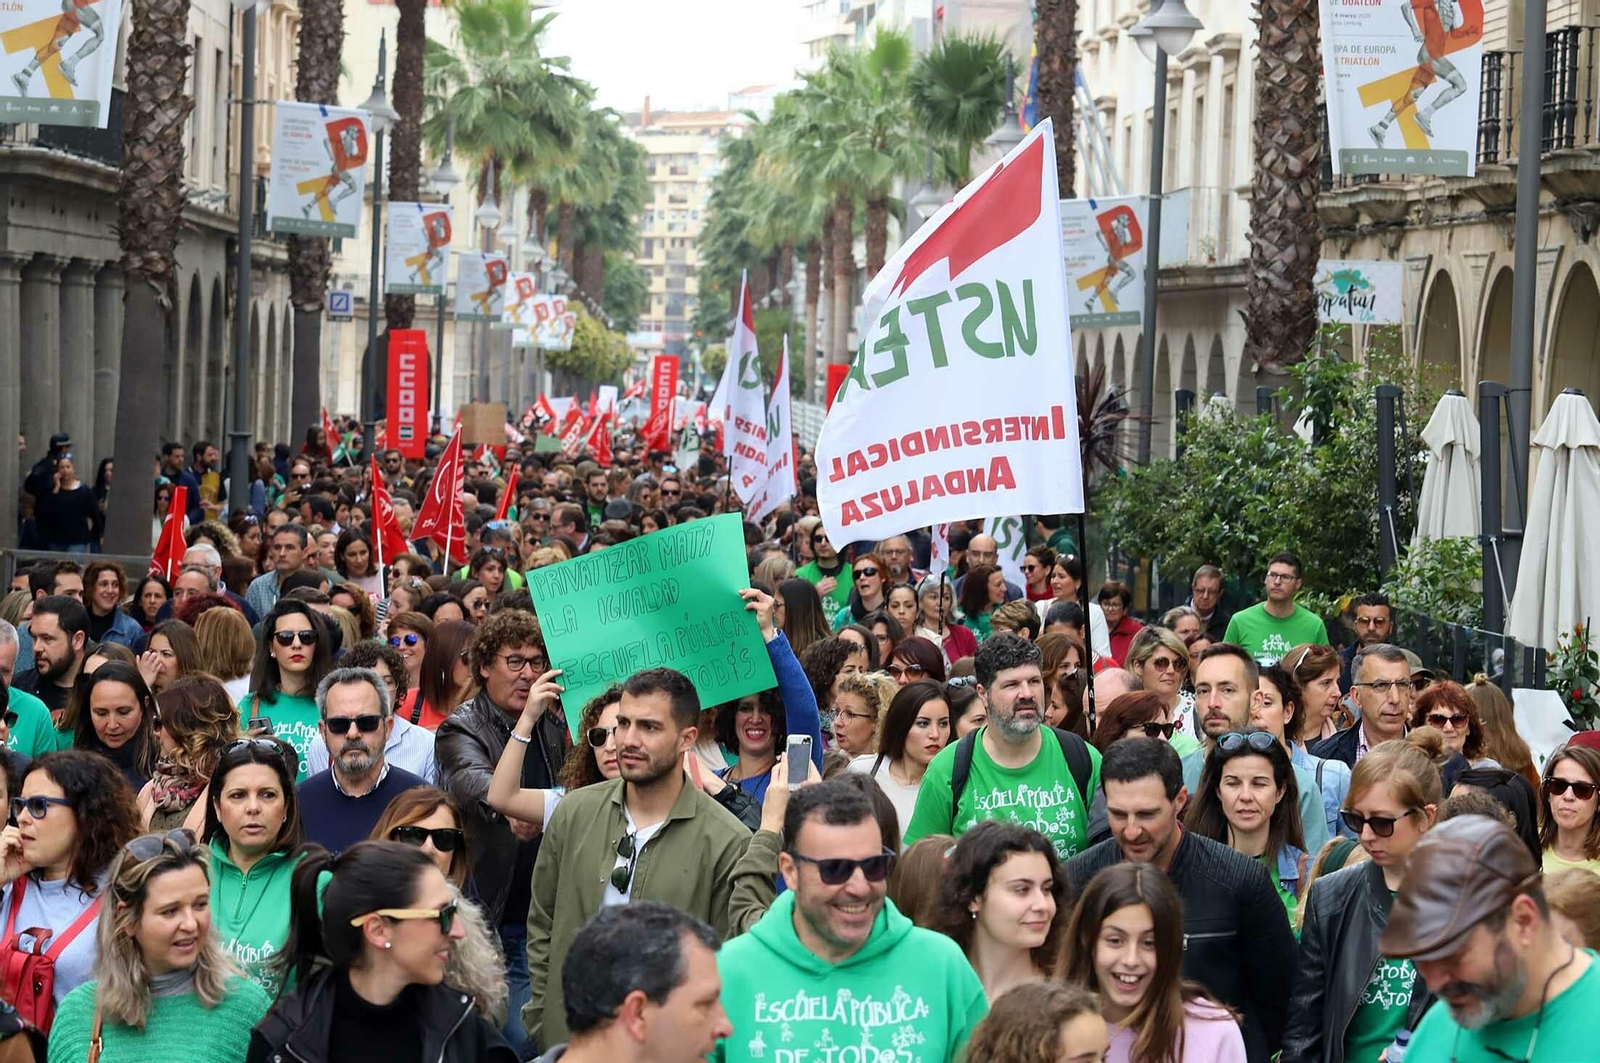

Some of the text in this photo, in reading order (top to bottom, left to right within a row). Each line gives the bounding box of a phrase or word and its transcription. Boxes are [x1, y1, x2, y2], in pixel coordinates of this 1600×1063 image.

[1341, 56, 1380, 66] TRIATLÓN
[1351, 45, 1361, 54] DE
[1363, 45, 1397, 54] EUROPA
[399, 353, 416, 423] CCOO
[533, 522, 716, 602] PRIVATIZAR MATA
[544, 577, 680, 638] LA IGUALDAD
[557, 631, 675, 692] ESCUELA
[1014, 819, 1070, 835] OD@S
[755, 995, 848, 1025] ESCUELA
